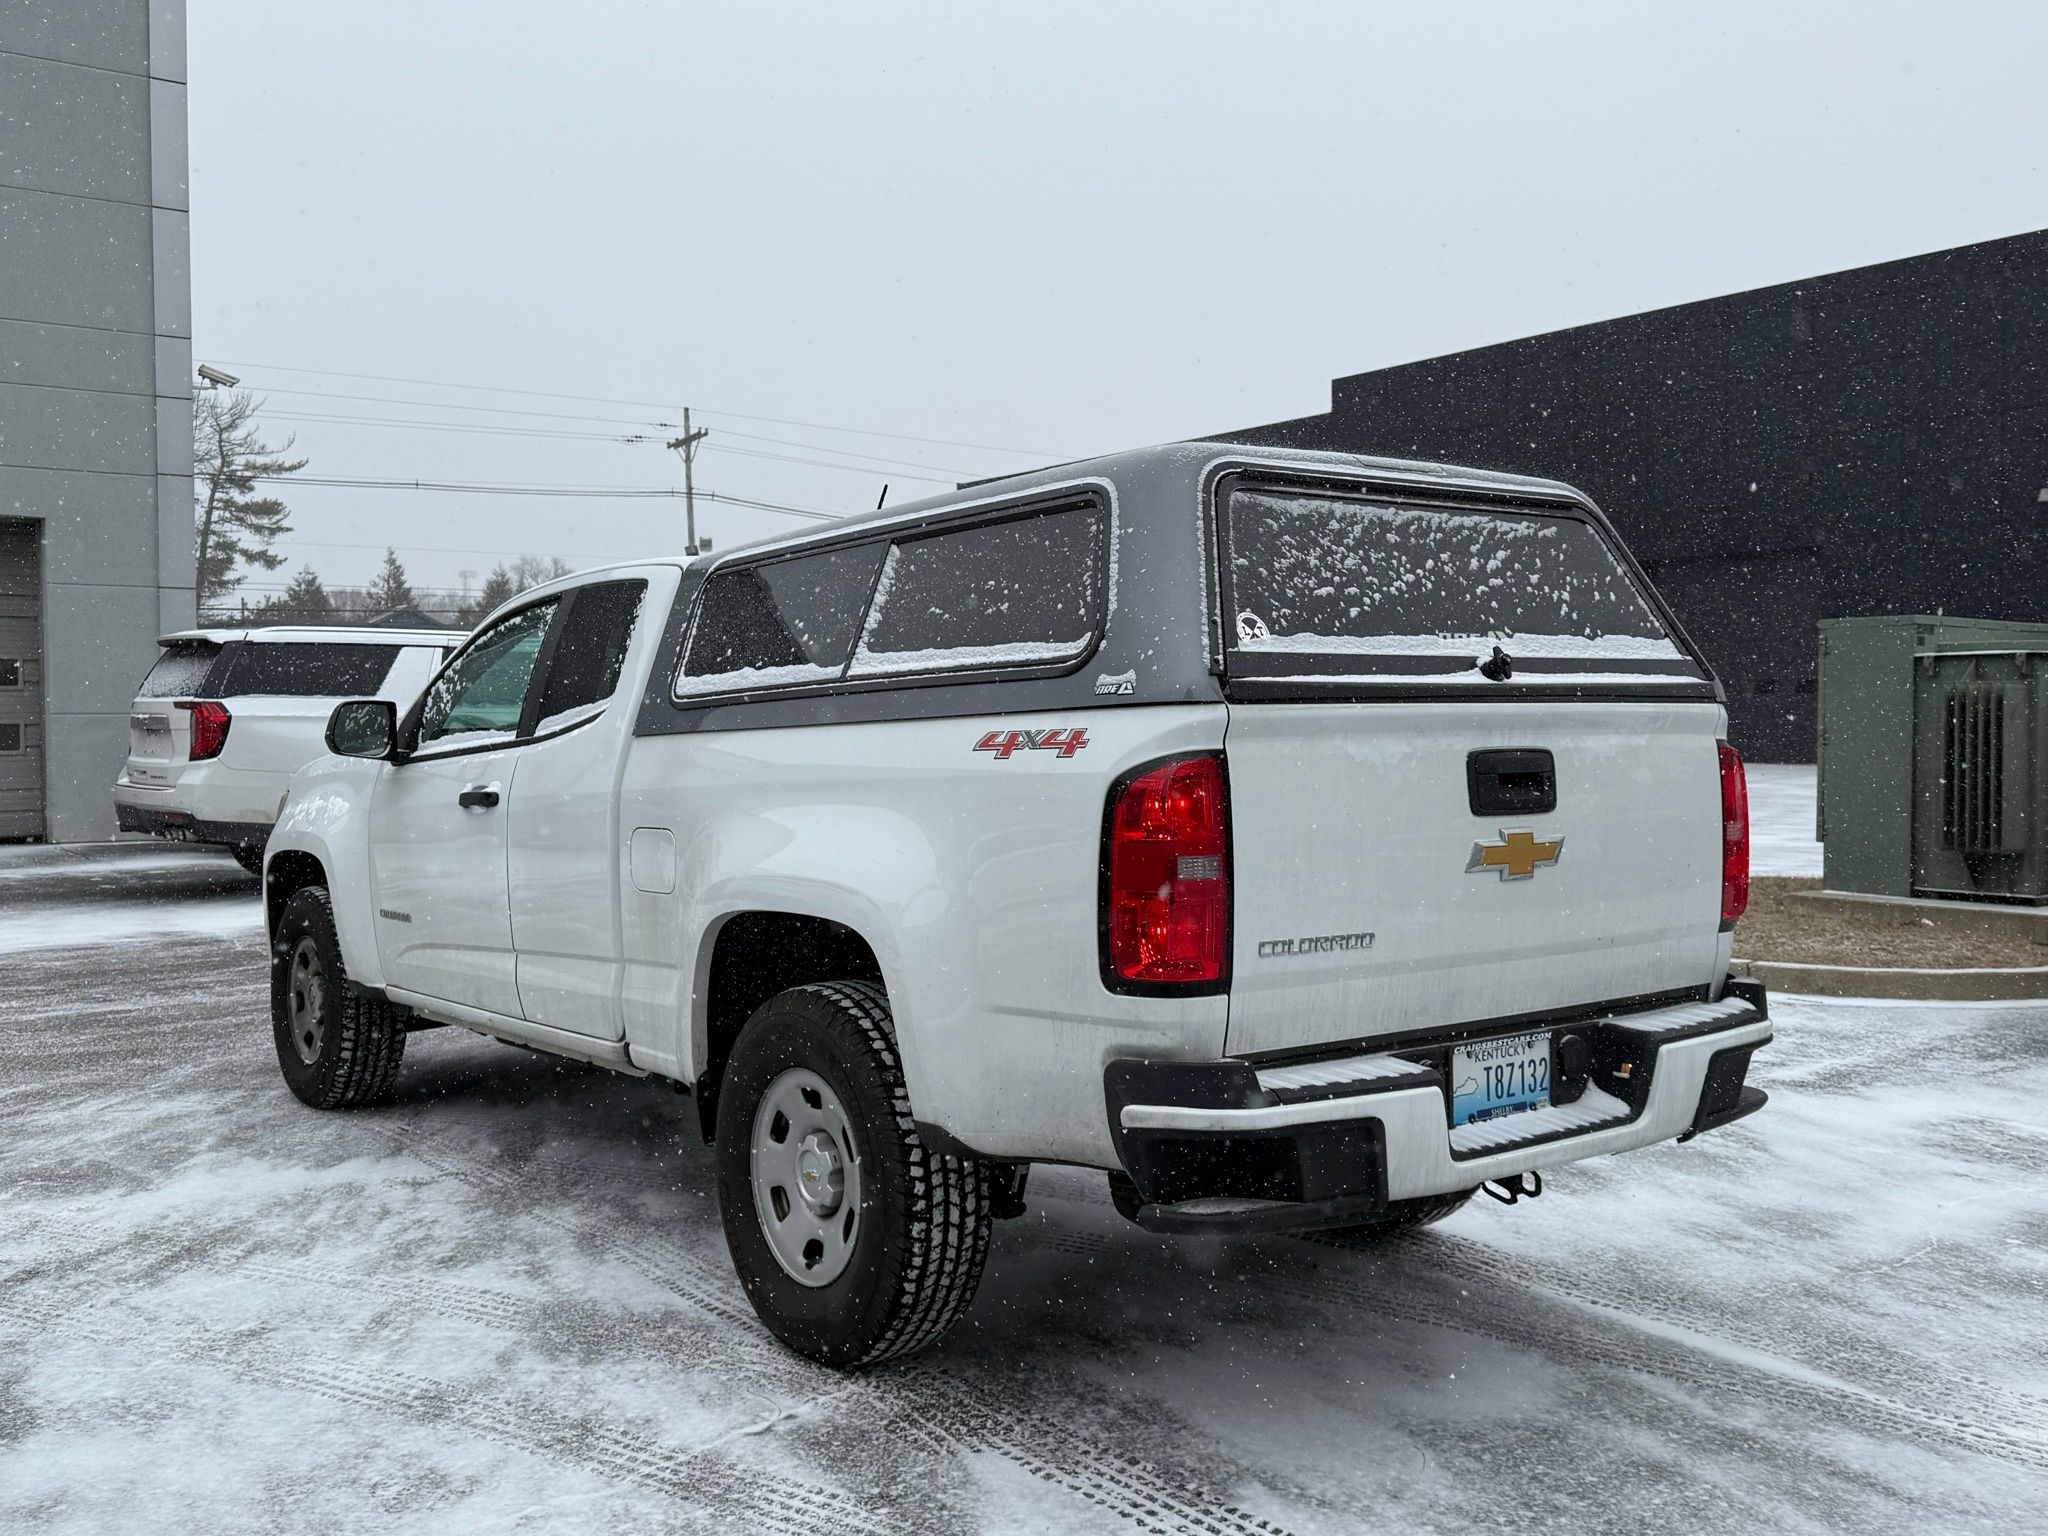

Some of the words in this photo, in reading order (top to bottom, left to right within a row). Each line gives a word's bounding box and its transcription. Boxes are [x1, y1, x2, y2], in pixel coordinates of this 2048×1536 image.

[1258, 932, 1376, 958] COLORADO
[1454, 1032, 1552, 1054] CRAIGSBESTCARS.COM
[1474, 1043, 1527, 1062] KENTUCKY
[1483, 1057, 1549, 1102] T8Z132
[1491, 1105, 1514, 1117] SHELBY
